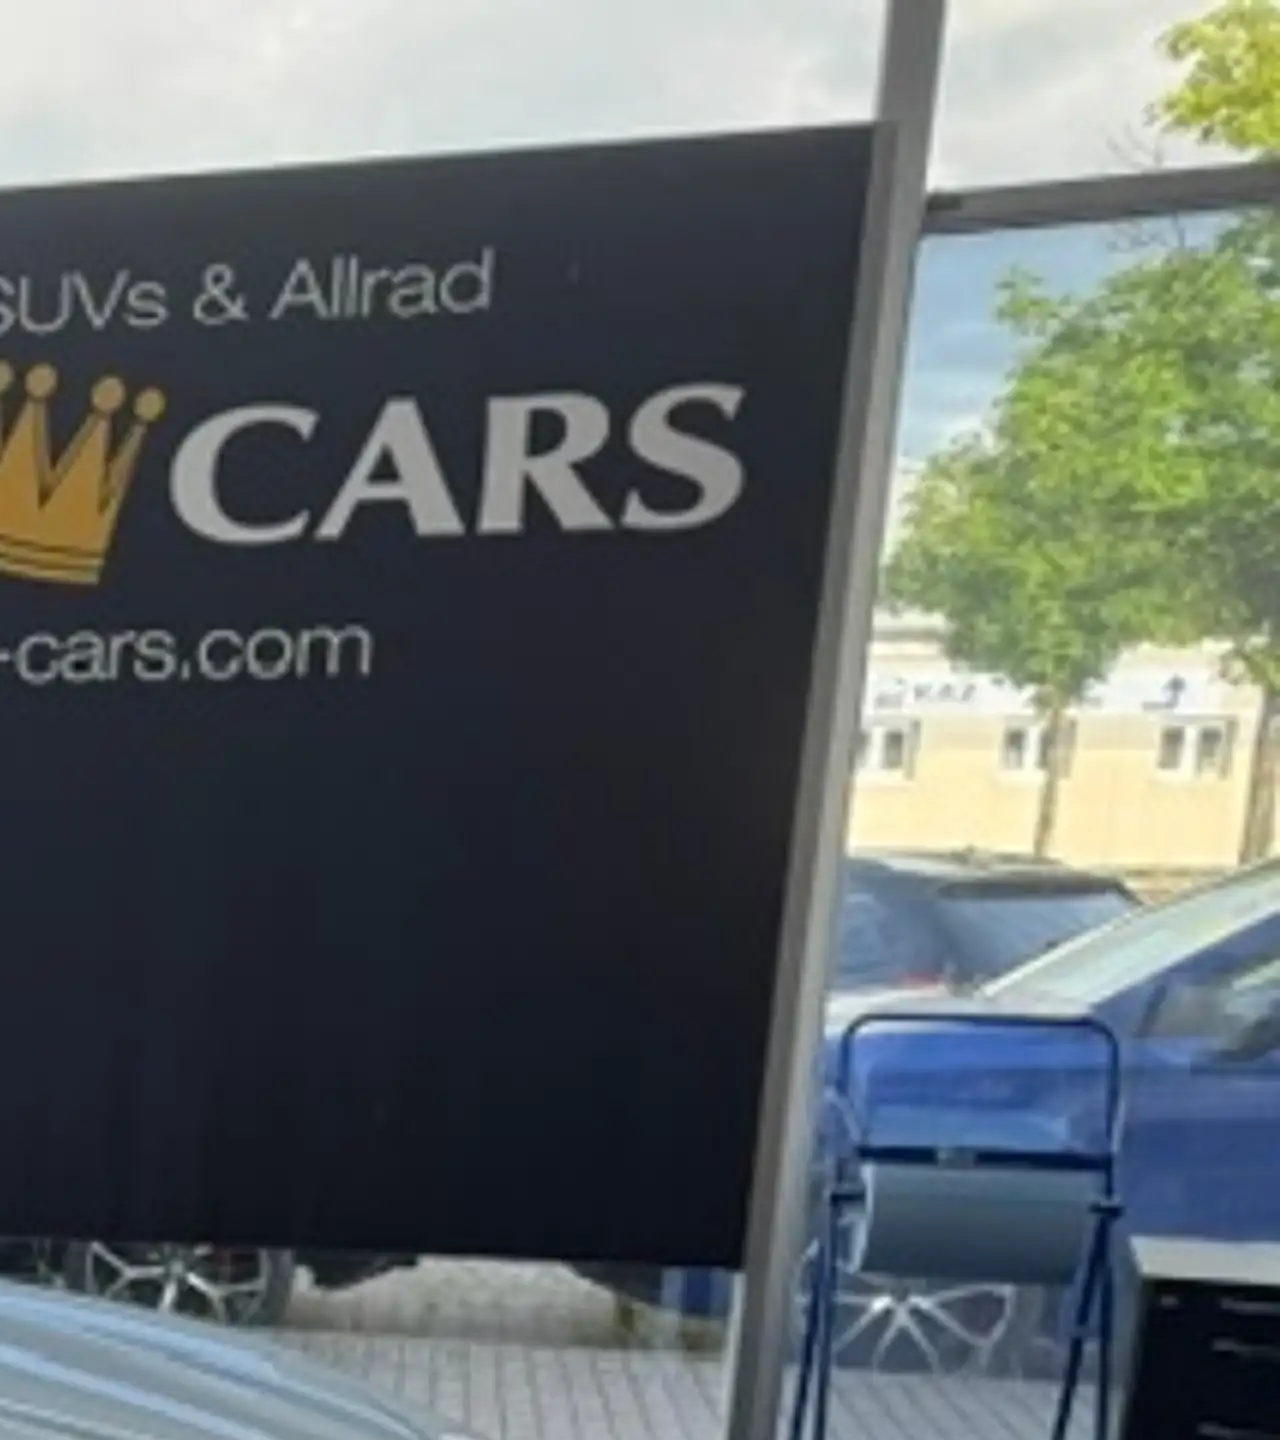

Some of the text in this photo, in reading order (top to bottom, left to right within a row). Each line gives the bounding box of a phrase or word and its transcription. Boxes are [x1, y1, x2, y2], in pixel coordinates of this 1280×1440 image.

[192, 262, 249, 326] &
[268, 245, 496, 320] Allrad
[169, 382, 746, 545] CARS
